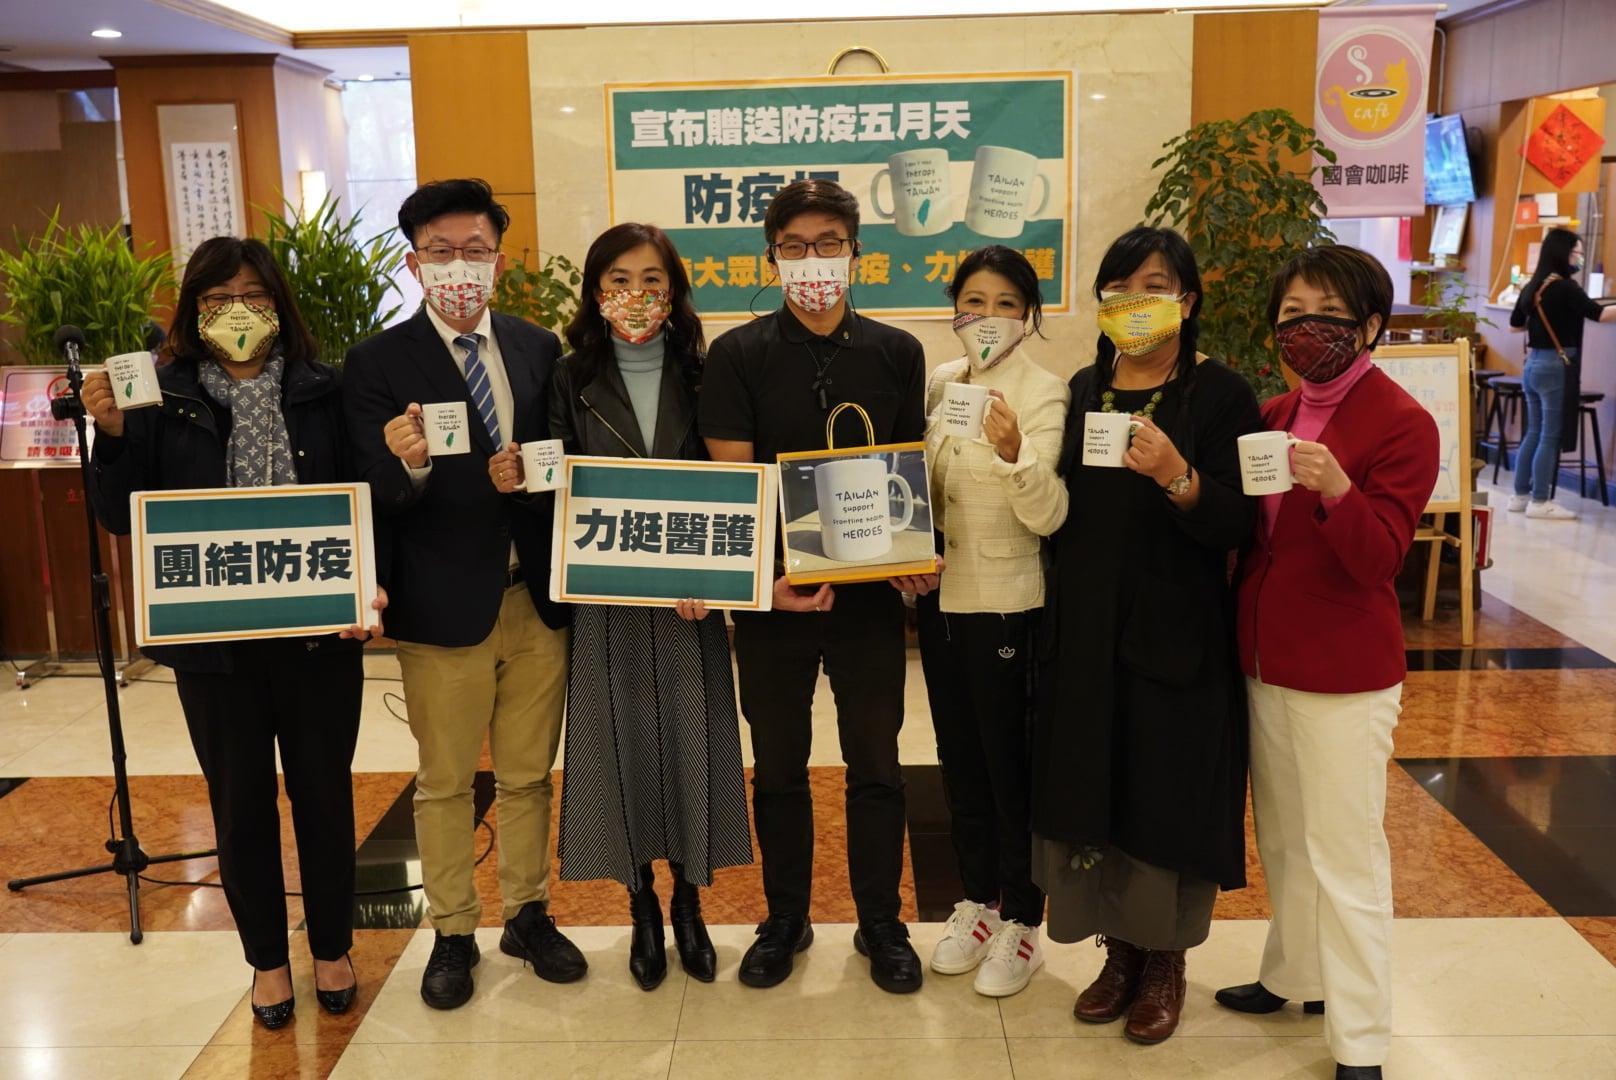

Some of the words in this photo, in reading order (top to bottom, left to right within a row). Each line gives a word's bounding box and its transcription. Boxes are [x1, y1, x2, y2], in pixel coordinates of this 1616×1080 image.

[631, 101, 971, 148] 宣布贈送防疫五月天
[988, 175, 1024, 187] TAIWAN
[1322, 163, 1409, 187] 國會咖啡
[684, 171, 839, 224] 防疫
[906, 186, 940, 196] TAIWAN
[984, 209, 1018, 220] HEROES
[835, 489, 879, 502] TAIWAN
[574, 508, 755, 557] 力挺醫護
[843, 525, 883, 539] HEROES
[154, 537, 352, 589] 團結防疫
